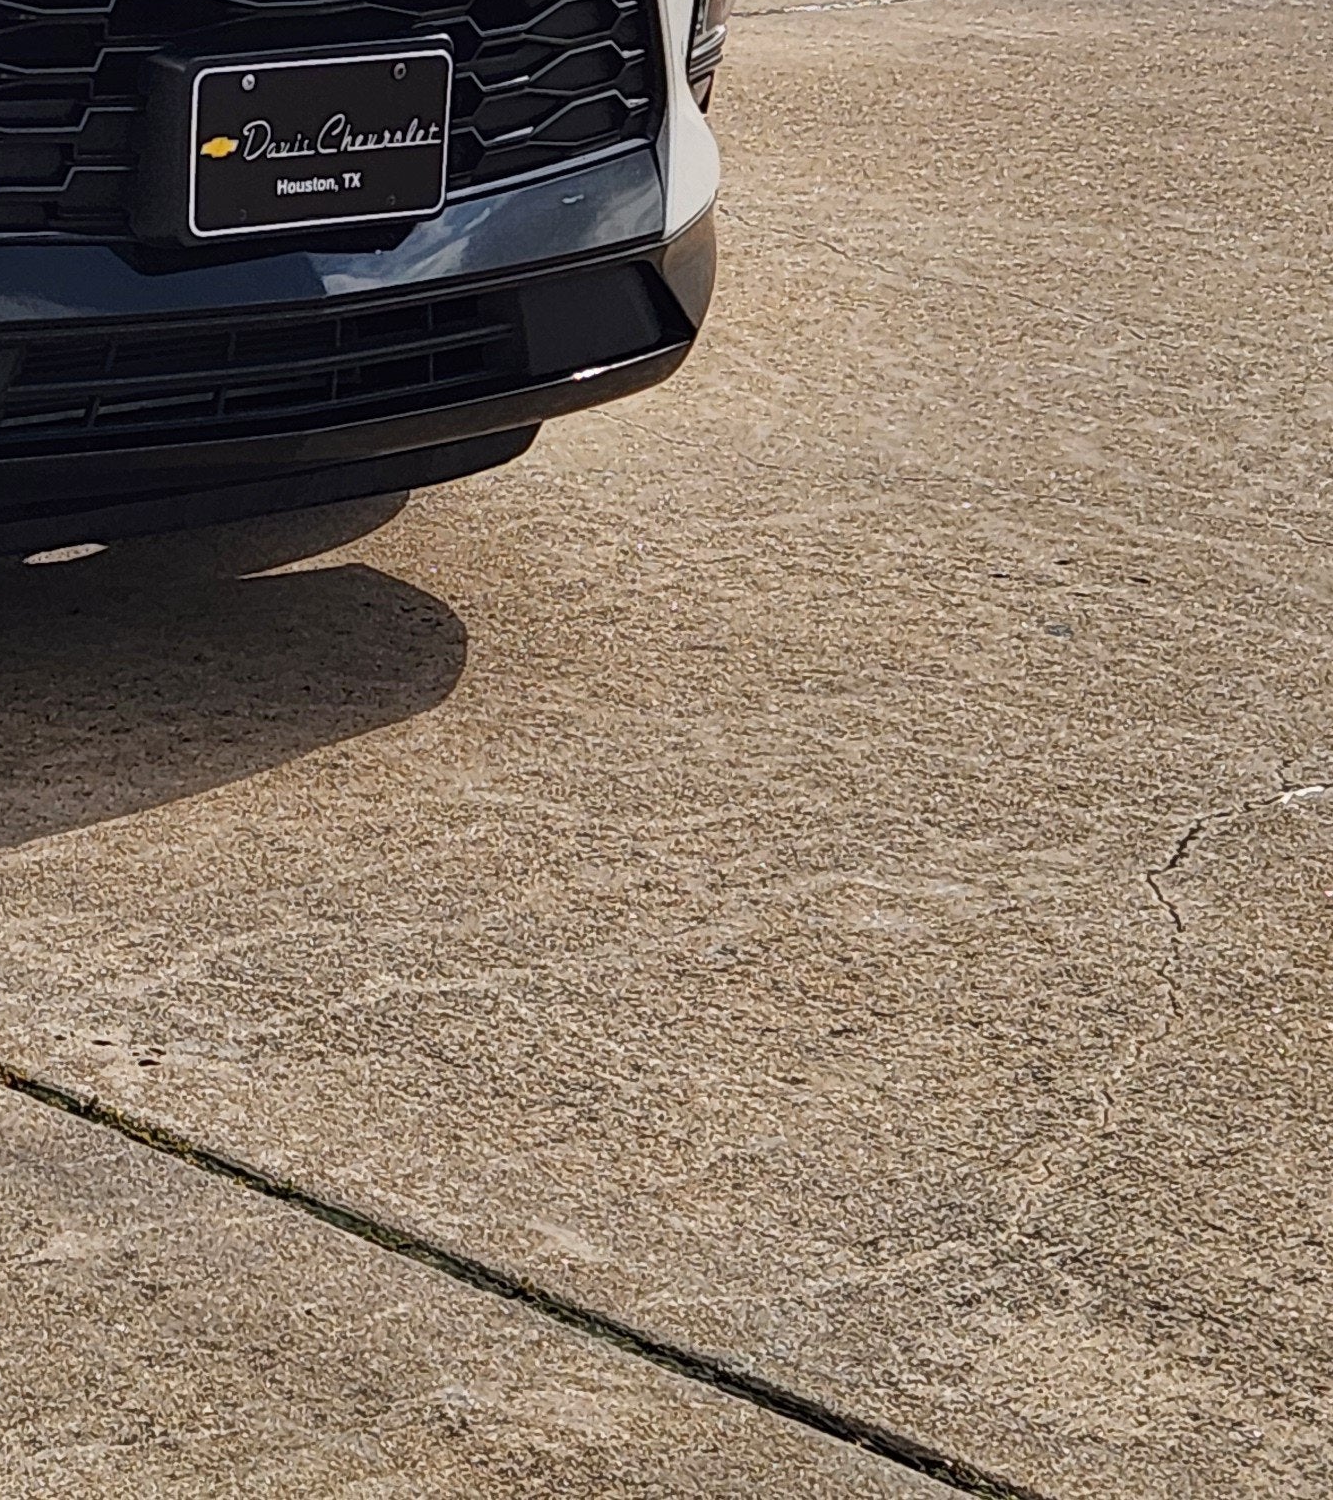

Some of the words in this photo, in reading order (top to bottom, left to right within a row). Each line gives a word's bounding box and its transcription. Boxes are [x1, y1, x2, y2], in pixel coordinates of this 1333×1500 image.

[242, 119, 316, 161] Davis
[317, 113, 442, 154] Chevrolet
[276, 177, 339, 195] Houston,
[342, 172, 362, 189] TX
